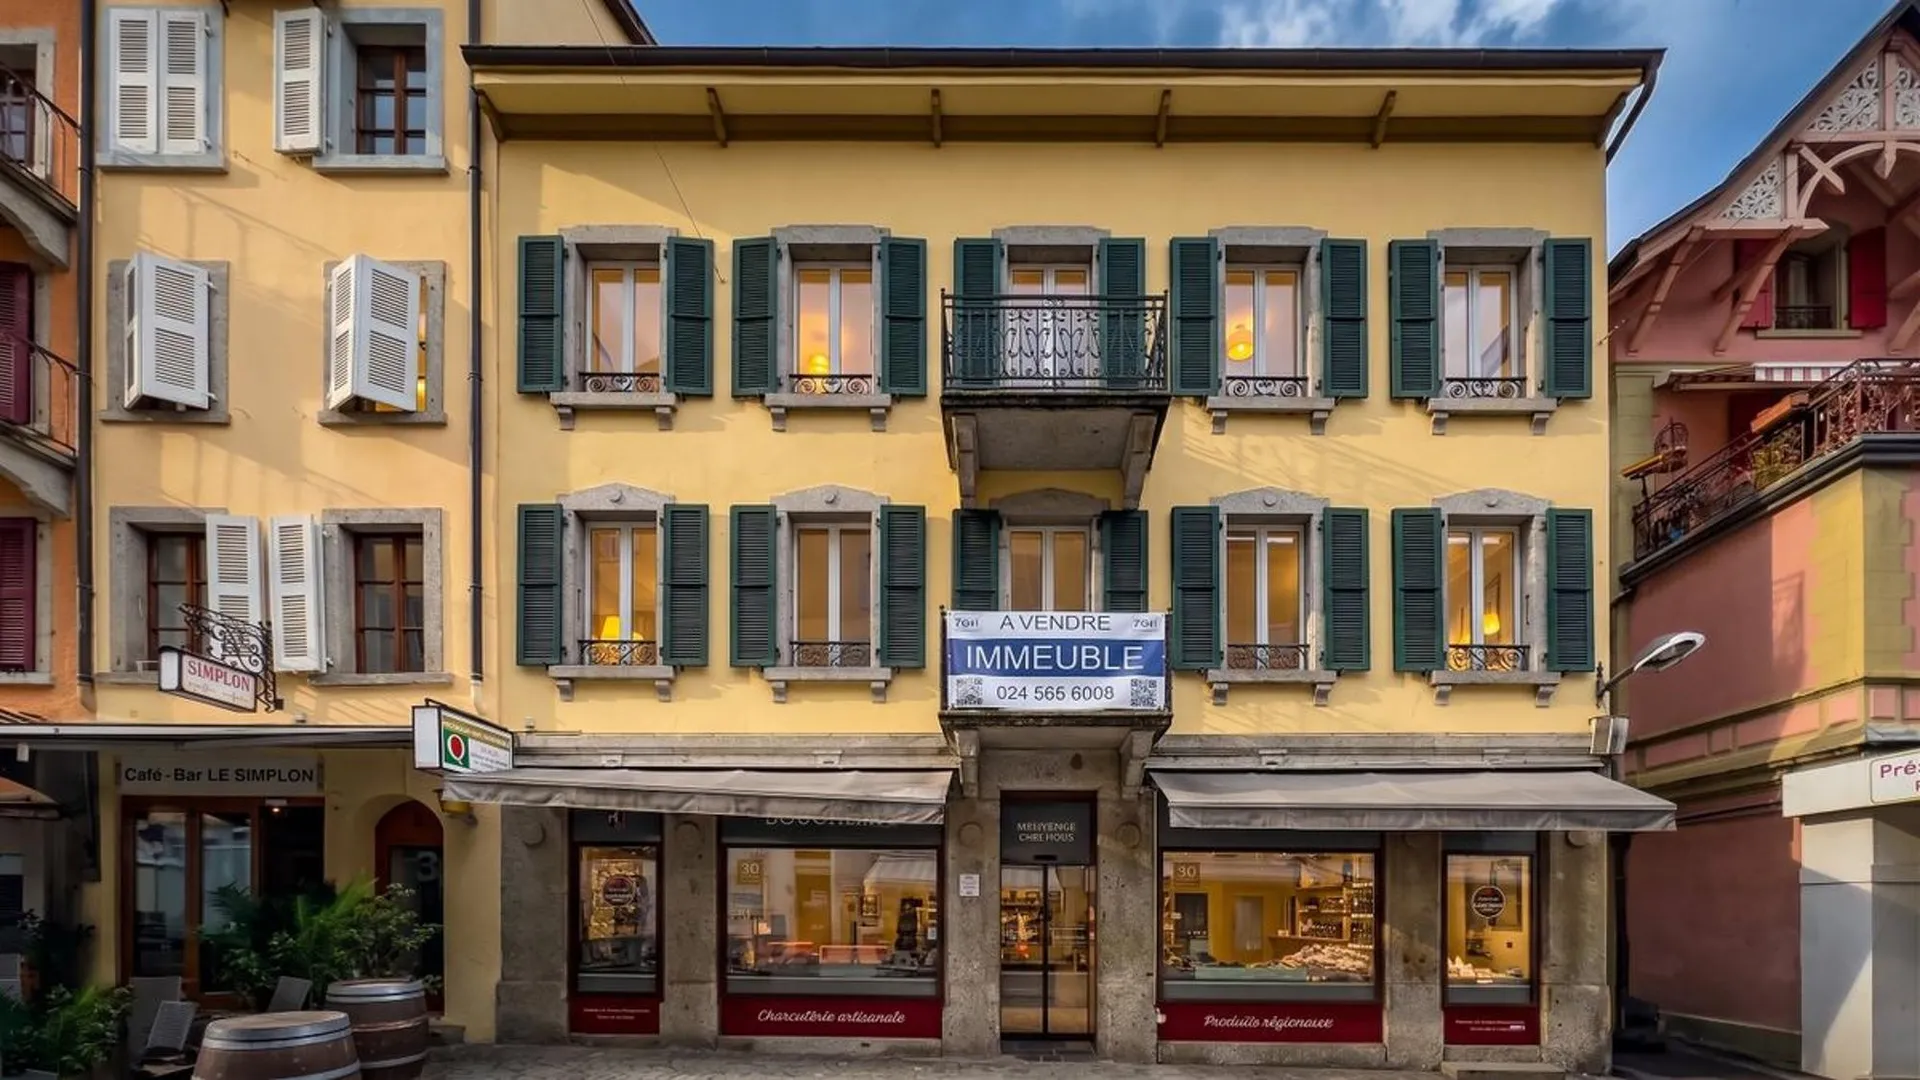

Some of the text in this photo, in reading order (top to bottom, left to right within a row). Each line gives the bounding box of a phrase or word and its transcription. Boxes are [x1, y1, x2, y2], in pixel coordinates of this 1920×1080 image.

[1000, 615, 1112, 631] A VENDRE
[966, 645, 1145, 670] IMMEUBLE
[188, 660, 250, 692] SIMPLON
[996, 686, 1028, 700] 024
[1071, 687, 1115, 700] 6008
[124, 767, 163, 782] Café
[173, 768, 202, 782] Bar
[208, 768, 230, 782] LE
[234, 768, 314, 783] SIMPLON
[1880, 759, 1920, 778] Pré
[416, 850, 437, 881] 3
[741, 862, 760, 875] 30
[1177, 866, 1197, 878] 30
[837, 1010, 906, 1024] artisanale
